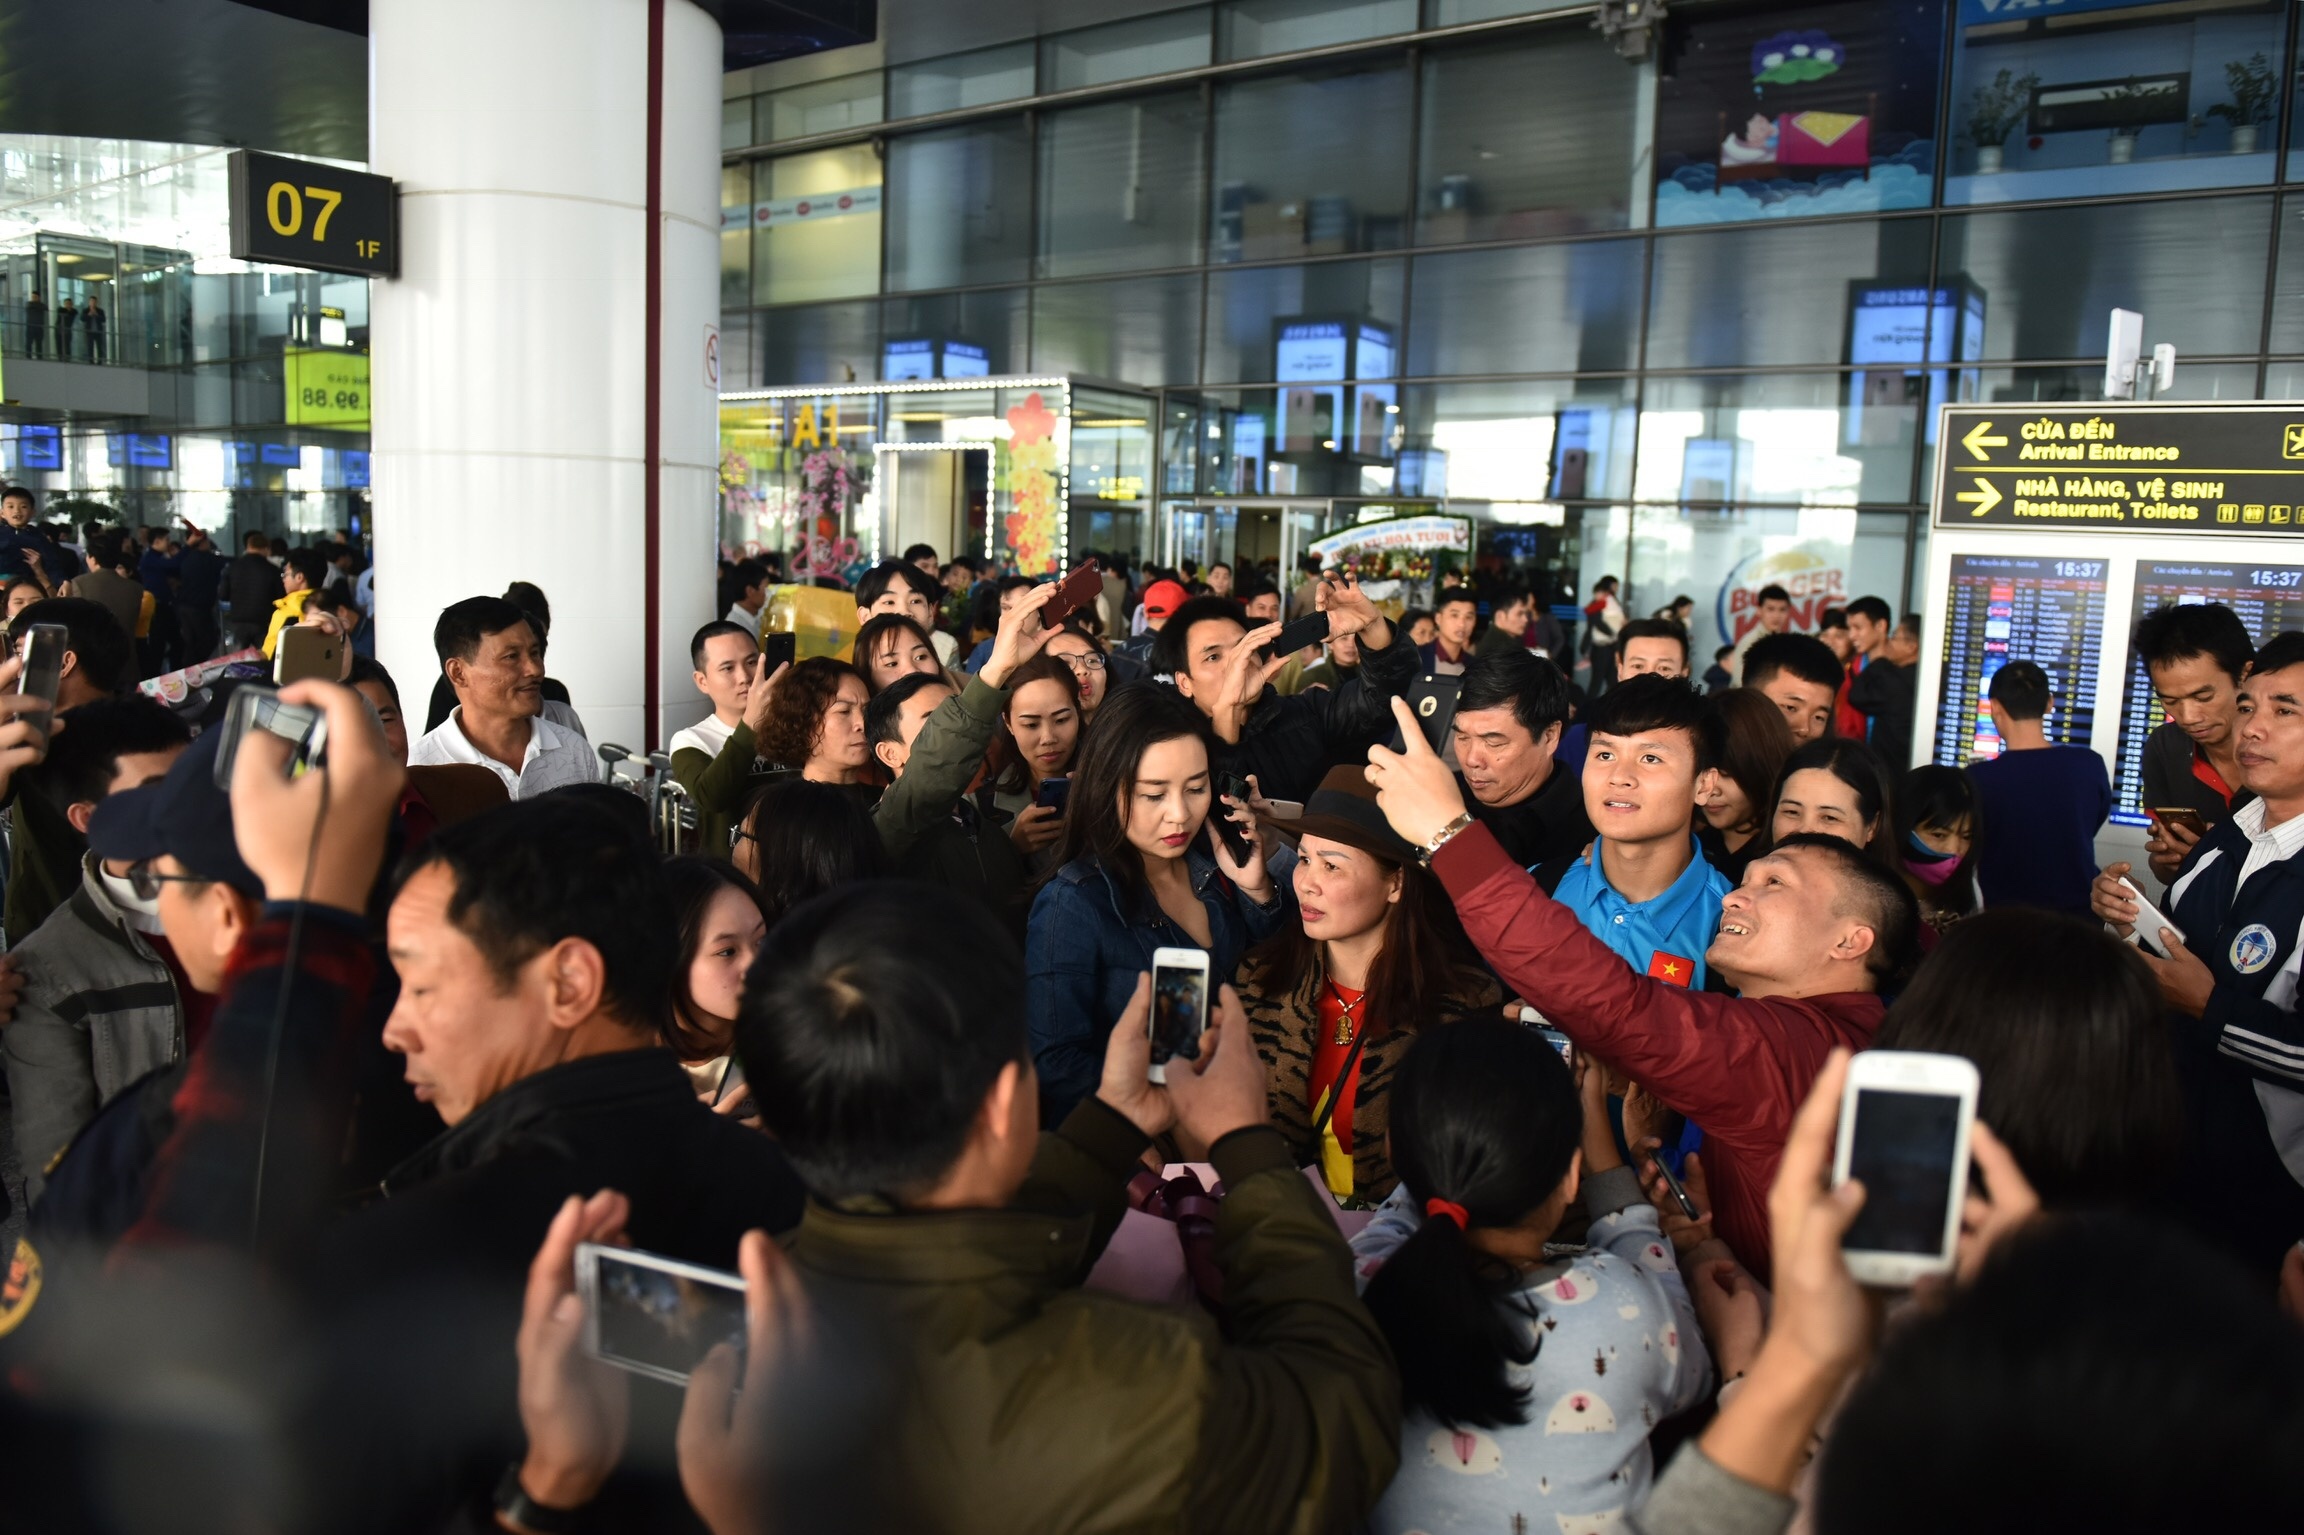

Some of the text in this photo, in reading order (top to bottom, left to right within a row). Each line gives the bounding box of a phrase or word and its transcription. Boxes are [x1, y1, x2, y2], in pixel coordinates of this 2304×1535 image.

[266, 181, 342, 242] 07
[356, 239, 381, 259] 1F
[792, 403, 840, 448] A1
[2020, 416, 2115, 440] CỬA ĐẾN
[2019, 443, 2180, 461] Arrival Entrance
[2015, 476, 2225, 501] NHÀ HÀNG, VỆ SINH
[2014, 499, 2199, 521] Restaurant, Toilets
[2054, 561, 2103, 578] 15:37
[2250, 570, 2303, 587] 15:37
